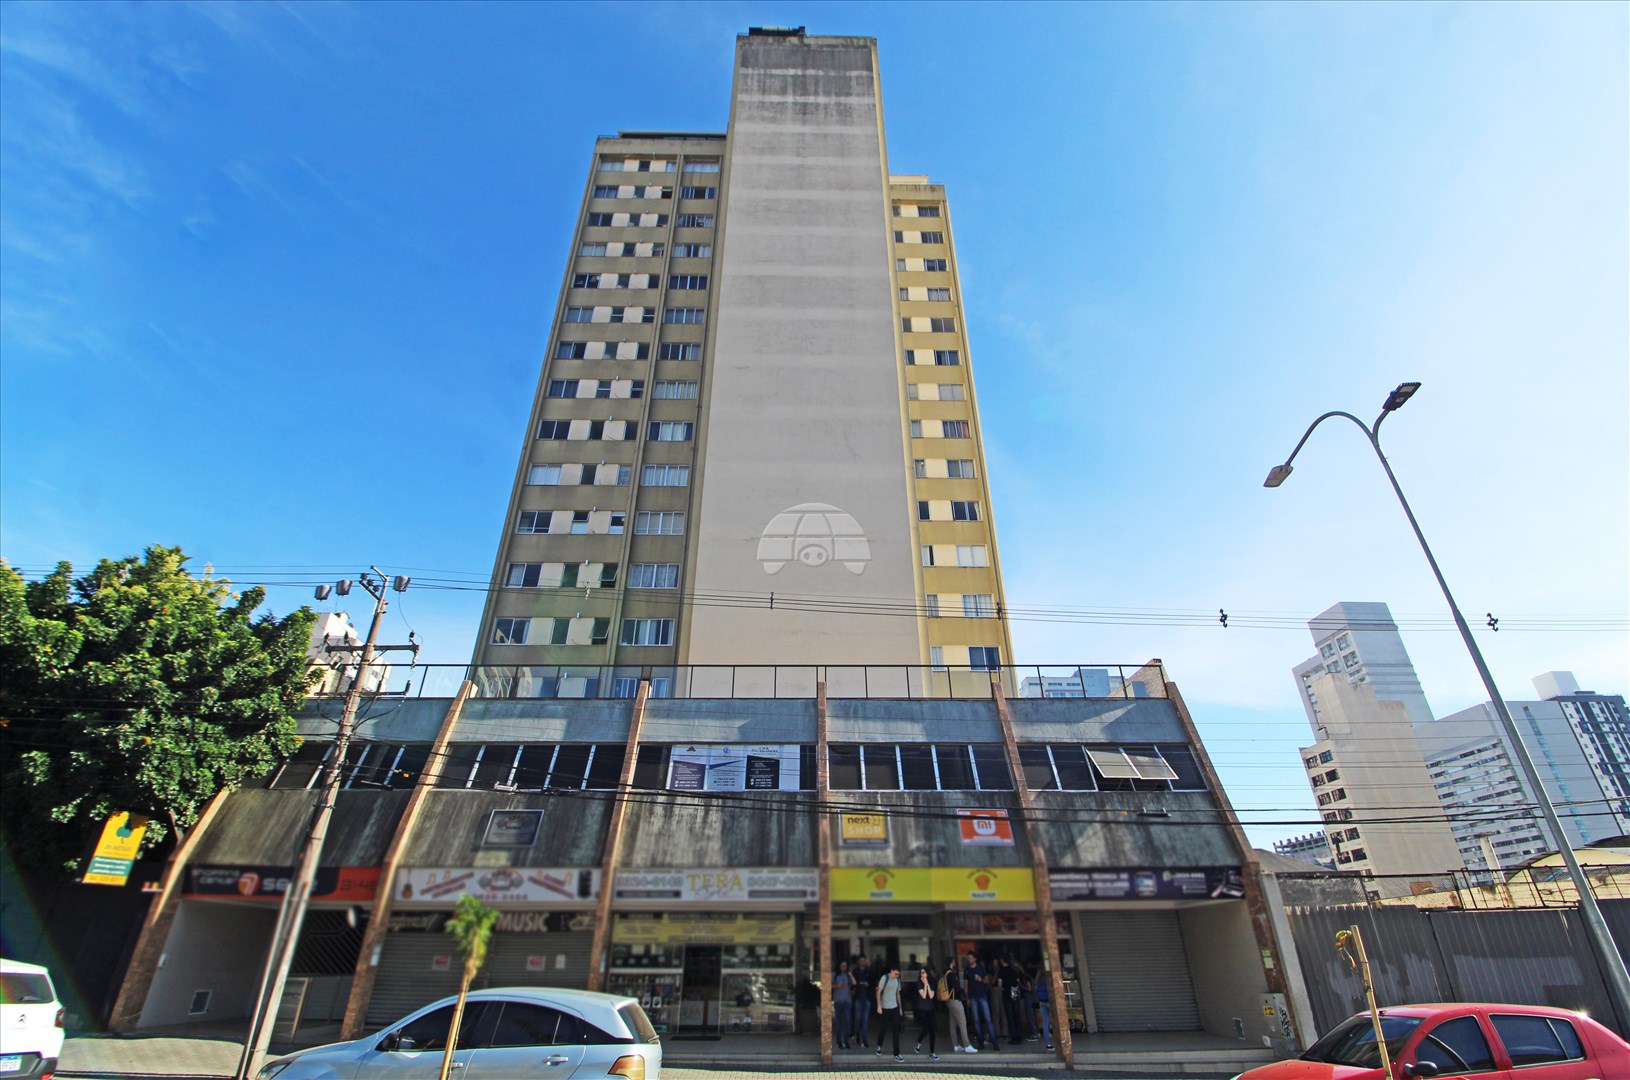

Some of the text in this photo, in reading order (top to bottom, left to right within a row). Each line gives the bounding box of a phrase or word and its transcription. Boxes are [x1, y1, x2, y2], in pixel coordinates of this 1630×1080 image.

[848, 816, 870, 824] next
[848, 826, 881, 835] SHOP
[687, 873, 745, 892] TERA
[496, 912, 550, 932] MUSIC
